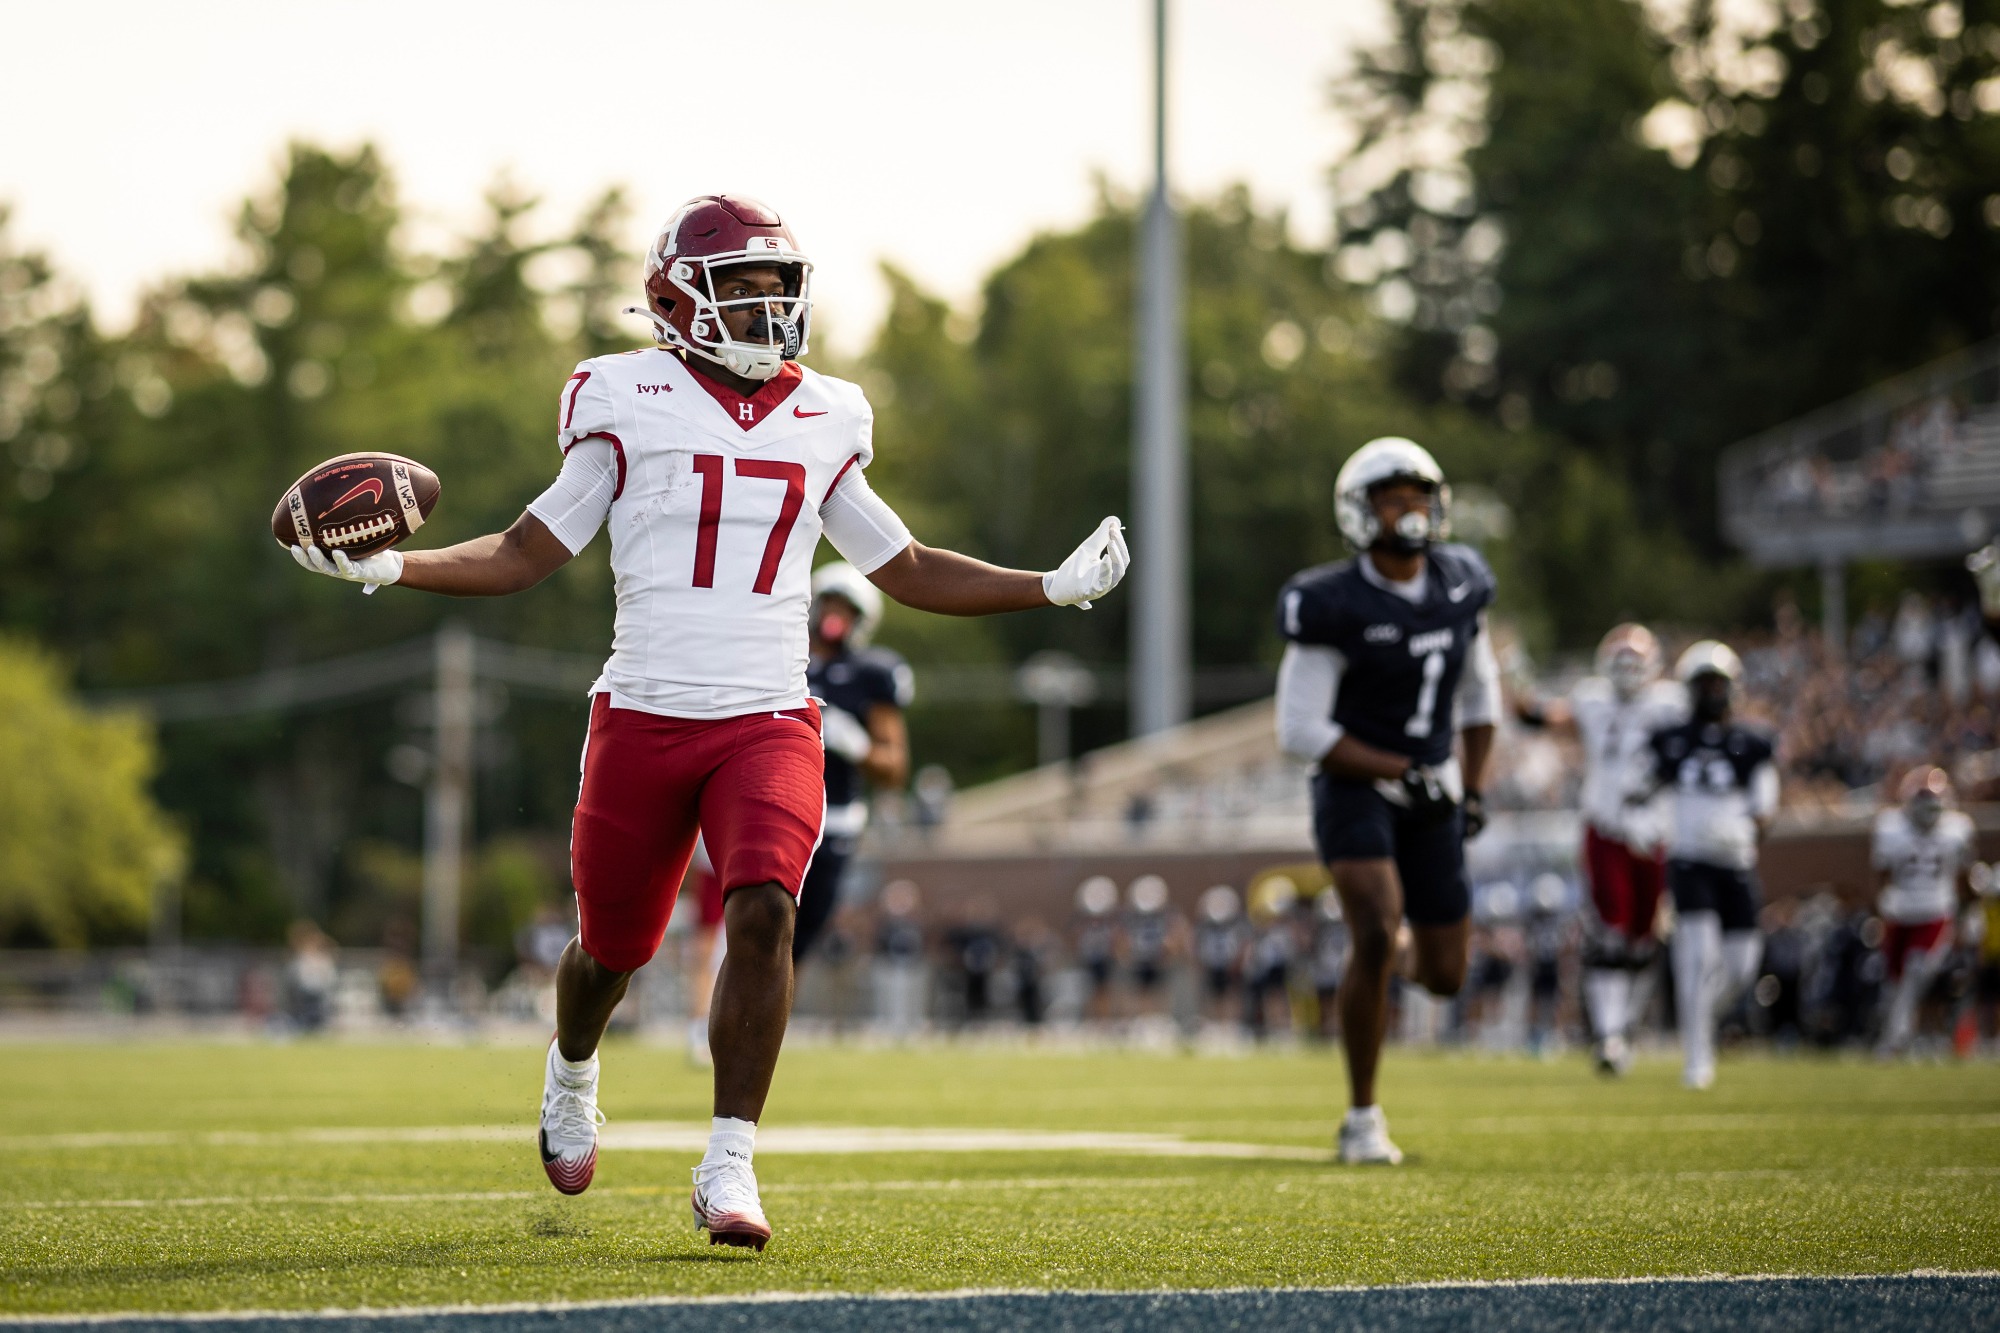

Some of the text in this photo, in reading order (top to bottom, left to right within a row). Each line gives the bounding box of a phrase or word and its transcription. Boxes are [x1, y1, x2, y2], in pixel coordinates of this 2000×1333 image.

[636, 383, 660, 396] Ivy
[738, 402, 754, 421] H
[692, 454, 806, 595] 17
[1404, 652, 1445, 738] 1
